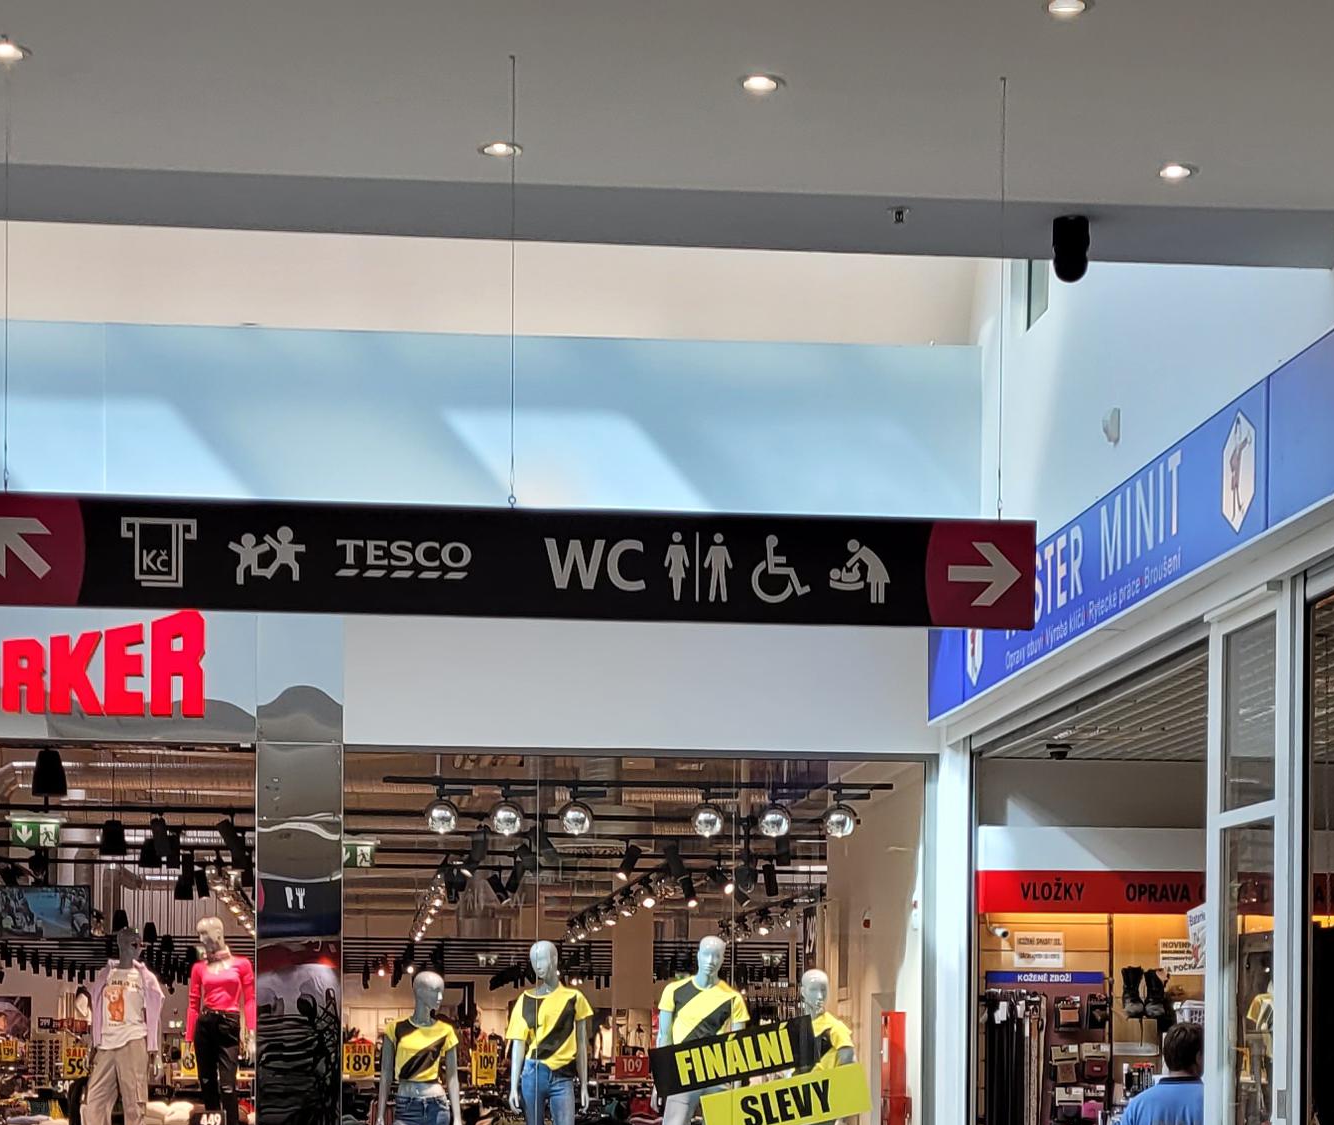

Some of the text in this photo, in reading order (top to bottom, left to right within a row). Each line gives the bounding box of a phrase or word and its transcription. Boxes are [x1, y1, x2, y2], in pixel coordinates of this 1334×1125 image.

[1100, 449, 1182, 582] MINIT
[142, 536, 646, 592] Kč TESCO WC
[1020, 877, 1191, 902] VLOŽKY OPRAVA
[479, 1052, 495, 1070] 109
[622, 1058, 643, 1073] 109
[674, 1021, 794, 1087] FINÁLNÍ
